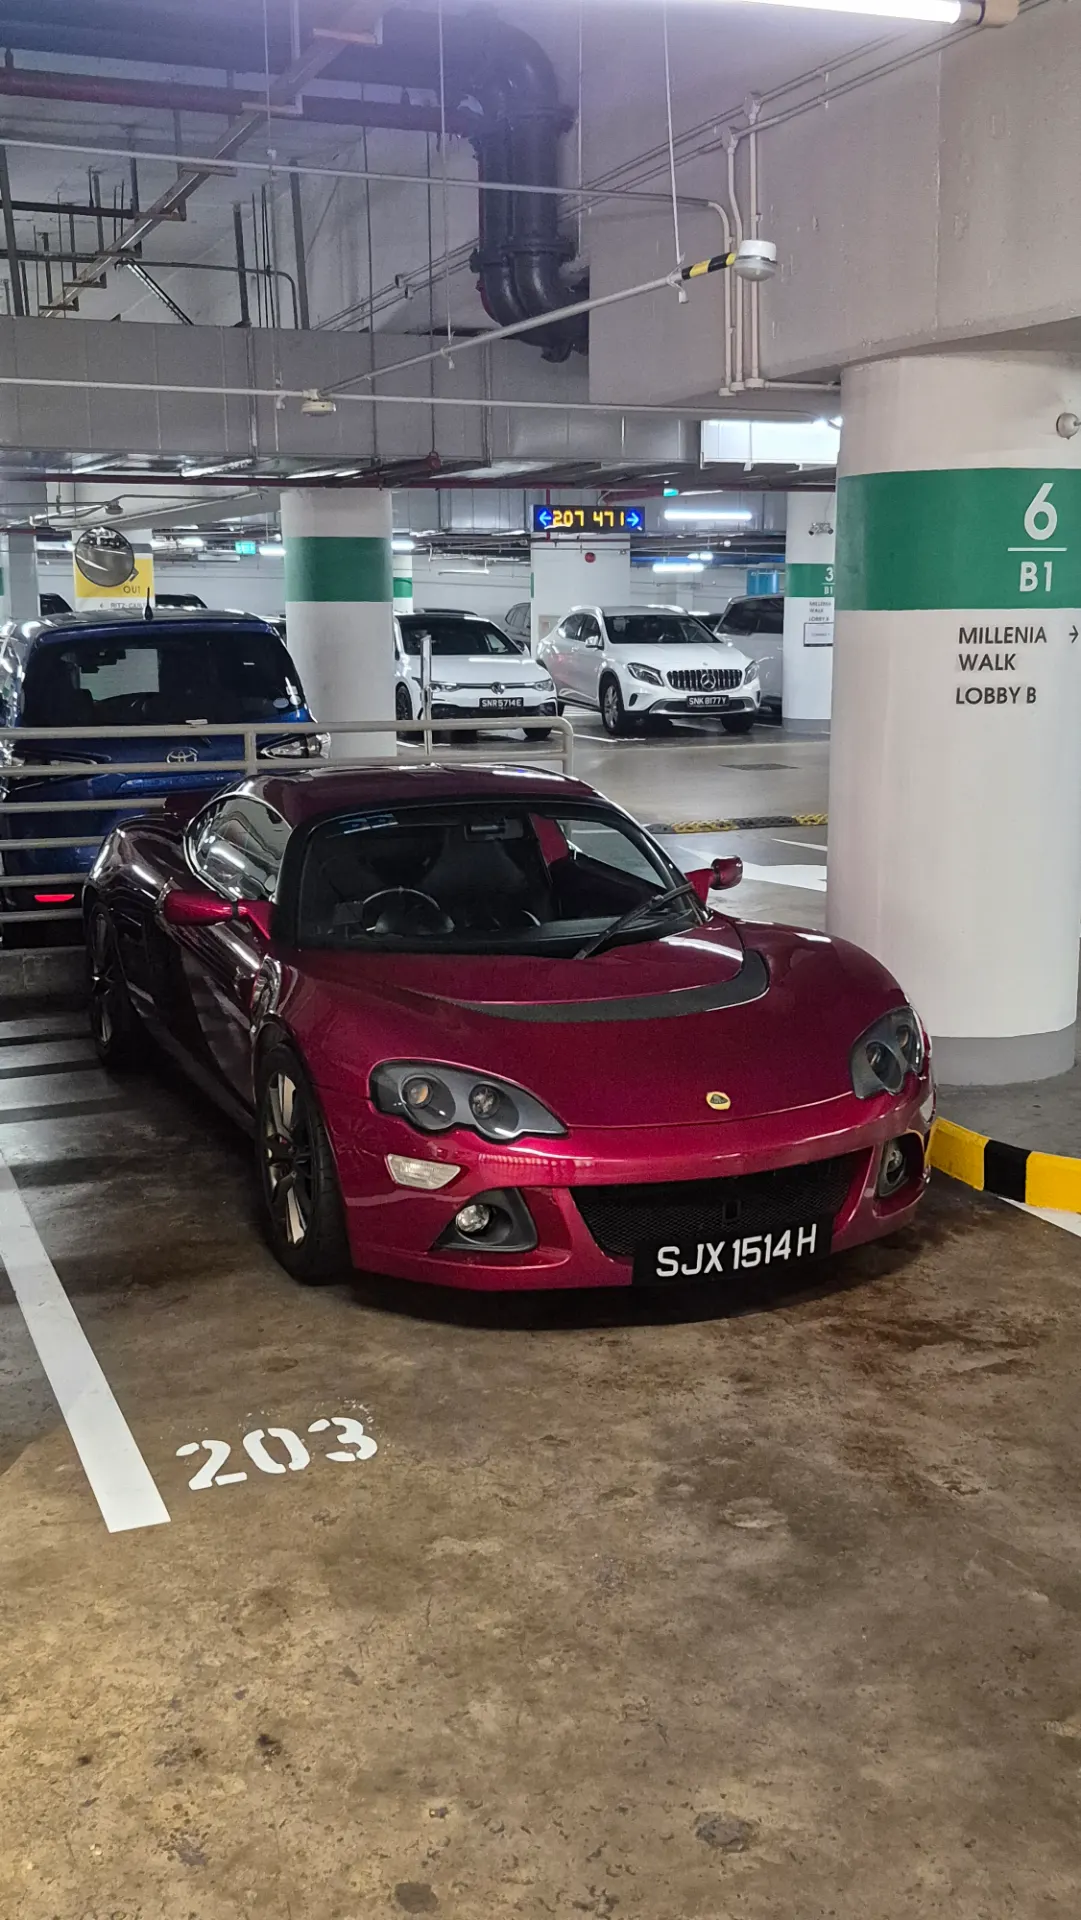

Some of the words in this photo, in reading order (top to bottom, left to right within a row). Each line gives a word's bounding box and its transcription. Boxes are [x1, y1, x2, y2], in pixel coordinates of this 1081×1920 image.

[552, 509, 584, 526] 207
[593, 510, 625, 527] 471
[1023, 482, 1058, 541] 6
[825, 566, 834, 582] 3
[1019, 561, 1053, 592] B1
[824, 586, 833, 595] B1
[958, 626, 1048, 645] MILLENIA
[958, 653, 1017, 672] WALK
[955, 686, 1021, 705] LOBBY
[1026, 686, 1037, 704] B
[175, 1416, 378, 1491] 203
